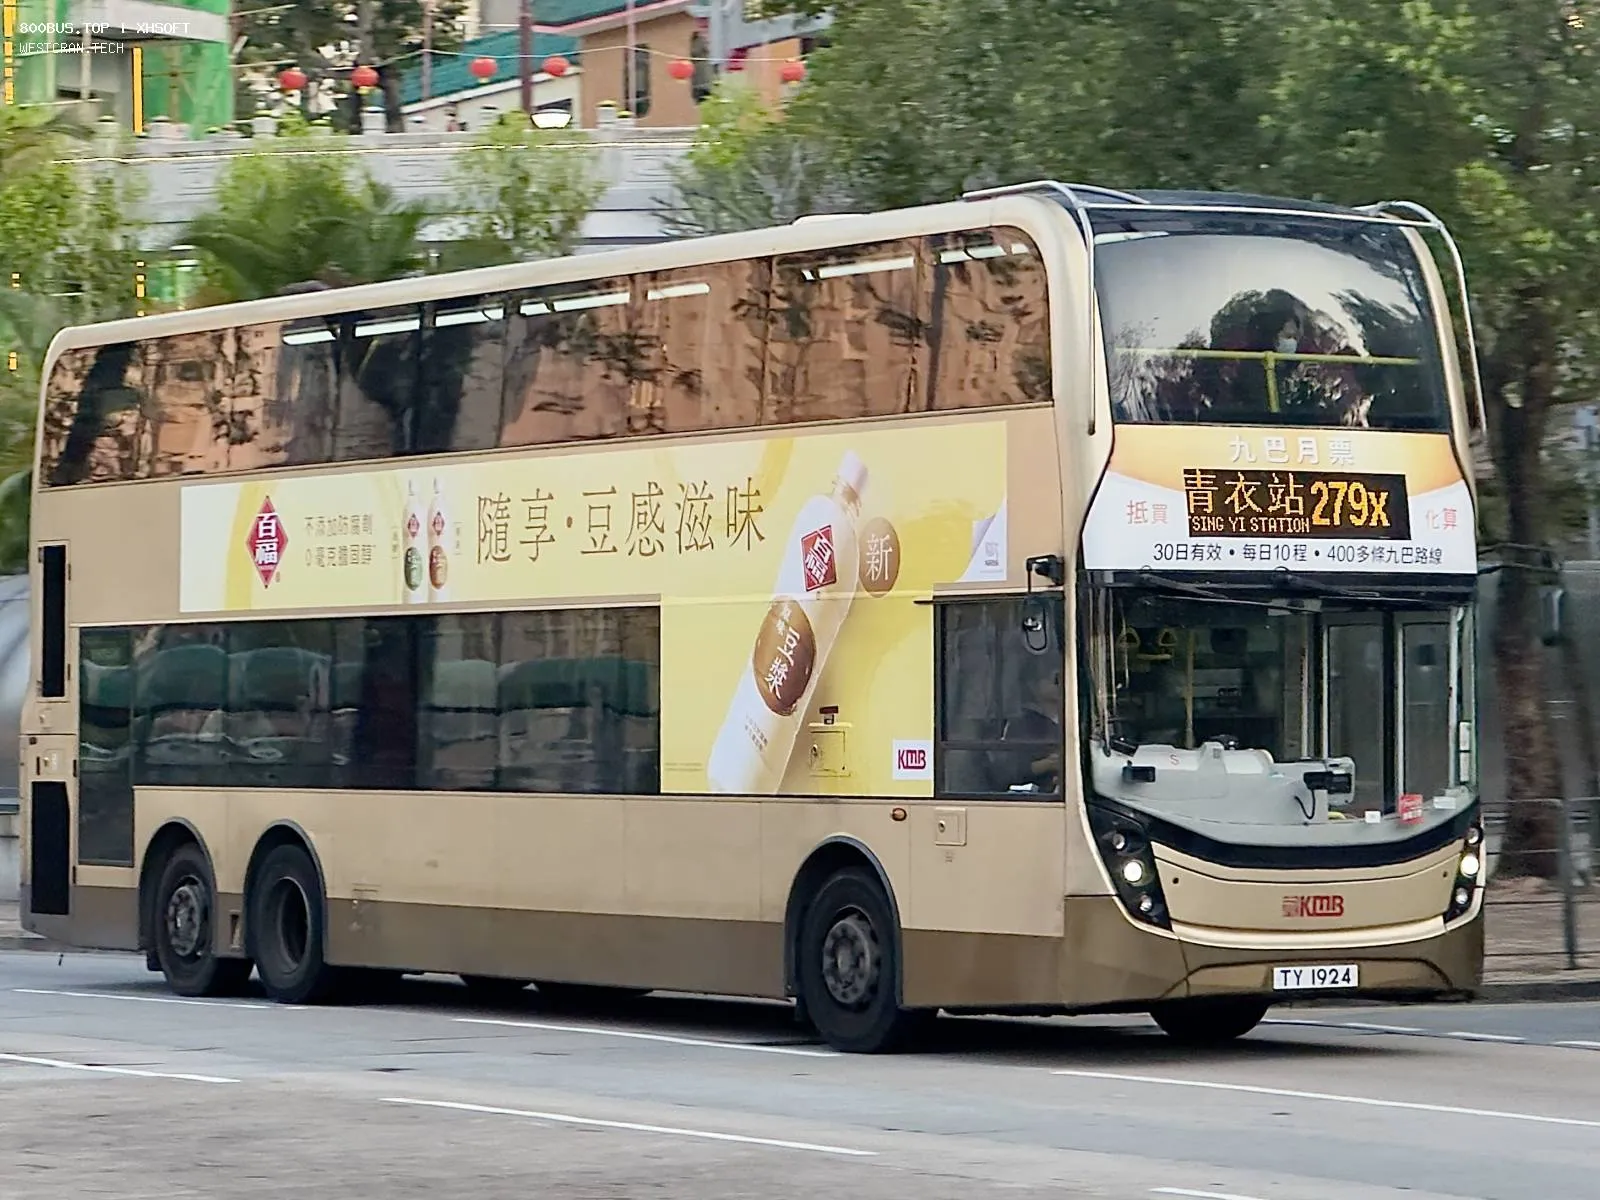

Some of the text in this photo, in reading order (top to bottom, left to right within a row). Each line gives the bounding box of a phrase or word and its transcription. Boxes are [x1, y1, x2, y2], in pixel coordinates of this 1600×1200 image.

[1229, 434, 1355, 466] 九巴月票
[1183, 468, 1305, 515] 青衣站
[1126, 499, 1168, 525] 抵買
[1228, 516, 1246, 532] YI
[1250, 517, 1310, 533] STATION
[865, 533, 893, 581] 新
[1153, 543, 1443, 565] 30日有效 每日10程 400多條九巴路線
[898, 749, 926, 769] KMB
[1300, 895, 1344, 917] KMB
[1280, 967, 1351, 986] TY 1924
